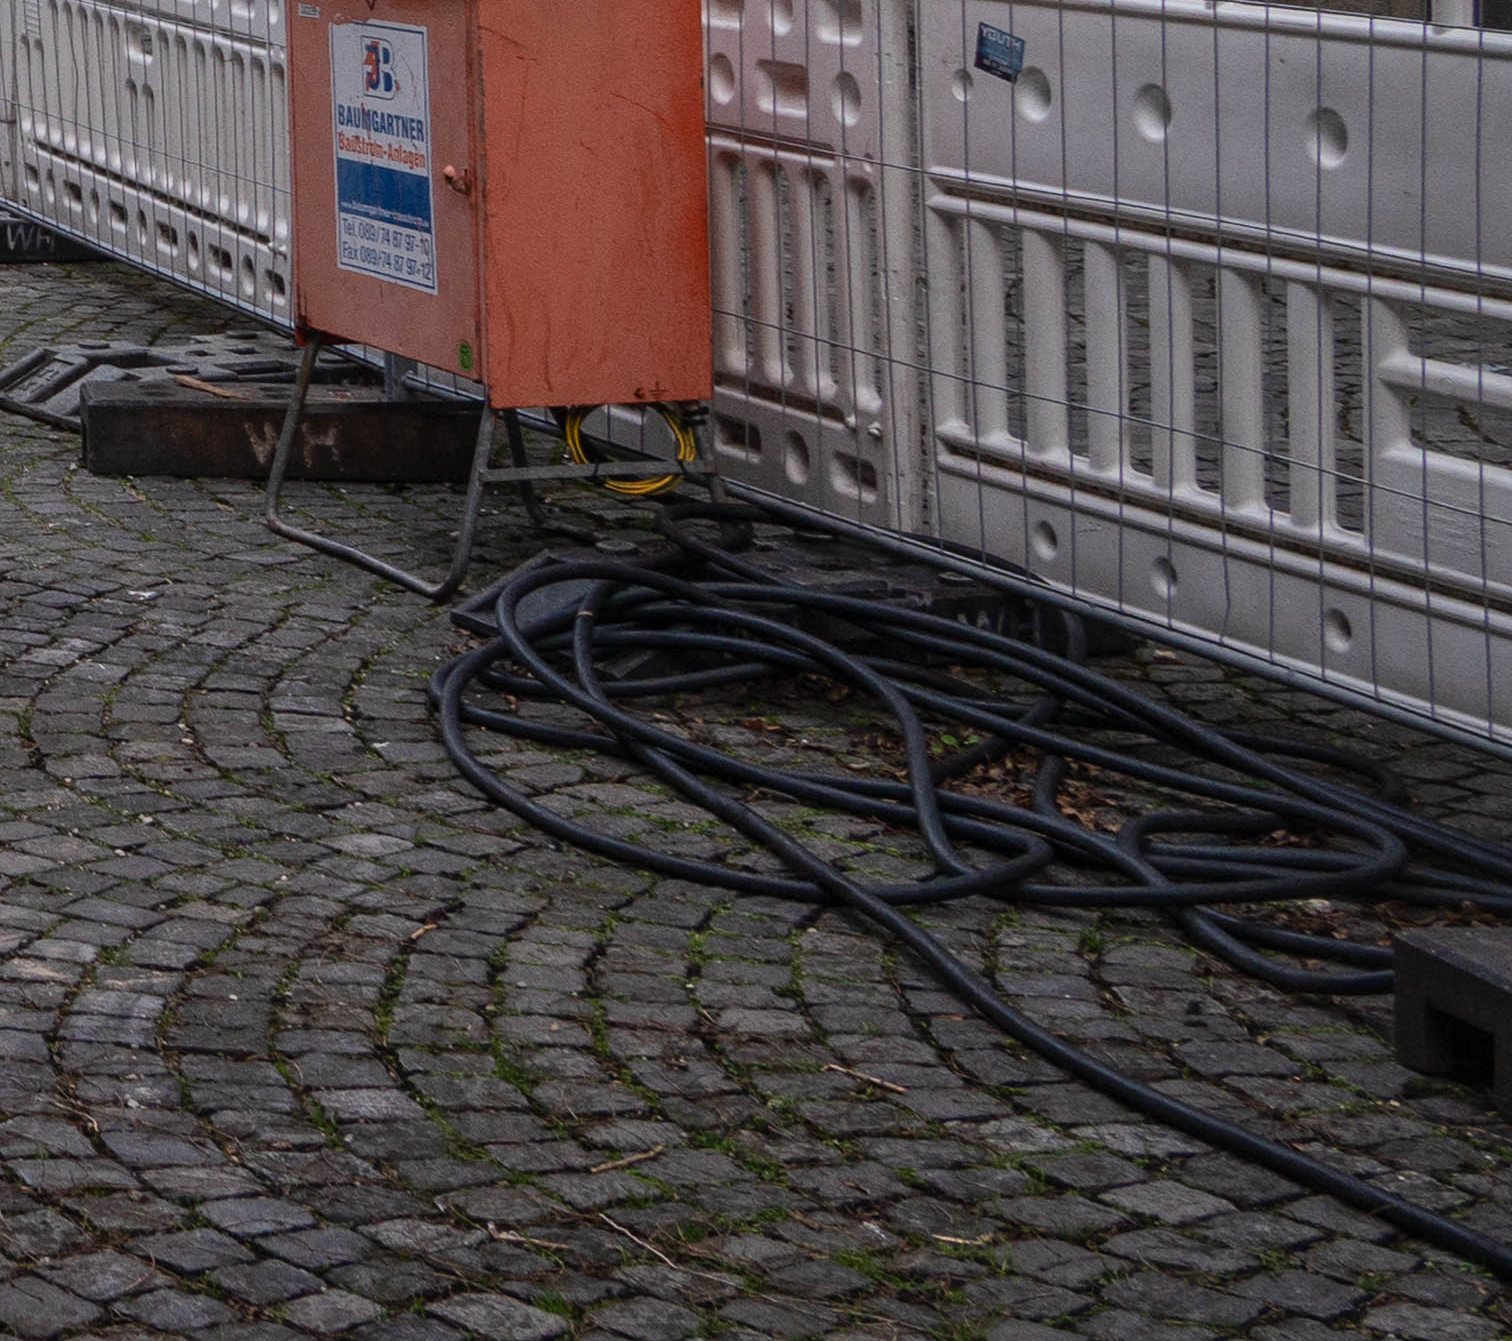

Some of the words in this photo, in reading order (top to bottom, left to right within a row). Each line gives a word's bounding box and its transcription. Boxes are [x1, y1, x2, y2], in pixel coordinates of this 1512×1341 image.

[337, 104, 425, 142] BAUMGARTNER
[338, 132, 426, 169] Baustrom-Anlagen
[6, 223, 55, 252] WH
[343, 241, 358, 261] Fax
